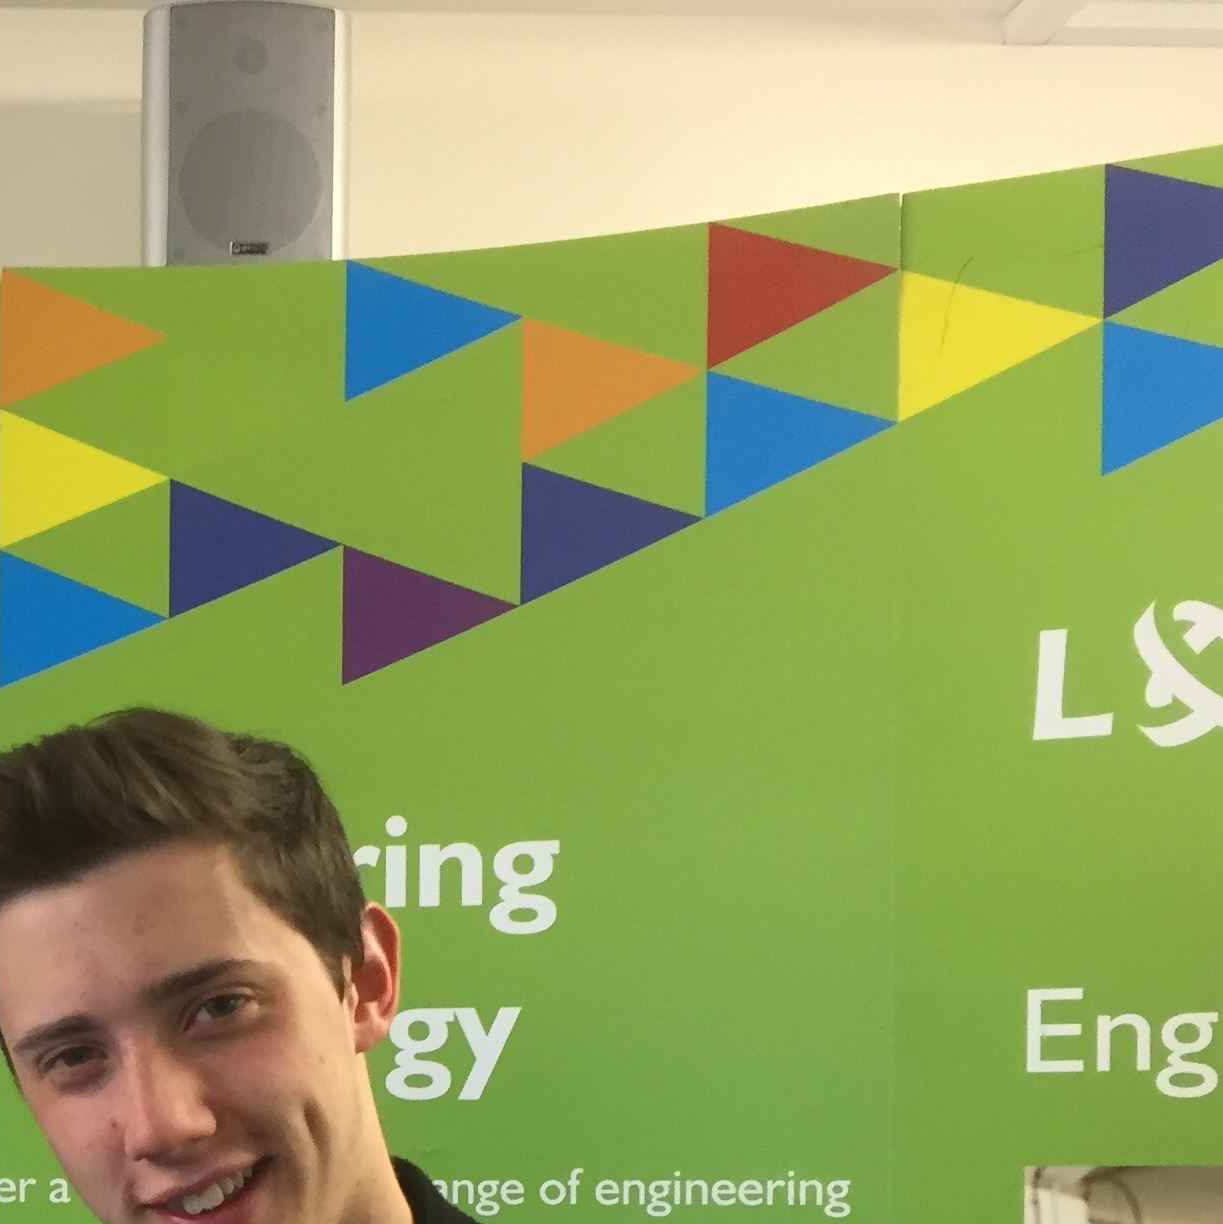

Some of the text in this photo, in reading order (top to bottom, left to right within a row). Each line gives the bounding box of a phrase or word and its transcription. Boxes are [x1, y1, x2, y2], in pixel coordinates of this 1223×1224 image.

[1026, 988, 1219, 1098] Eng
[49, 1178, 71, 1203] a
[539, 1168, 584, 1205] of
[595, 1171, 851, 1218] engineering
